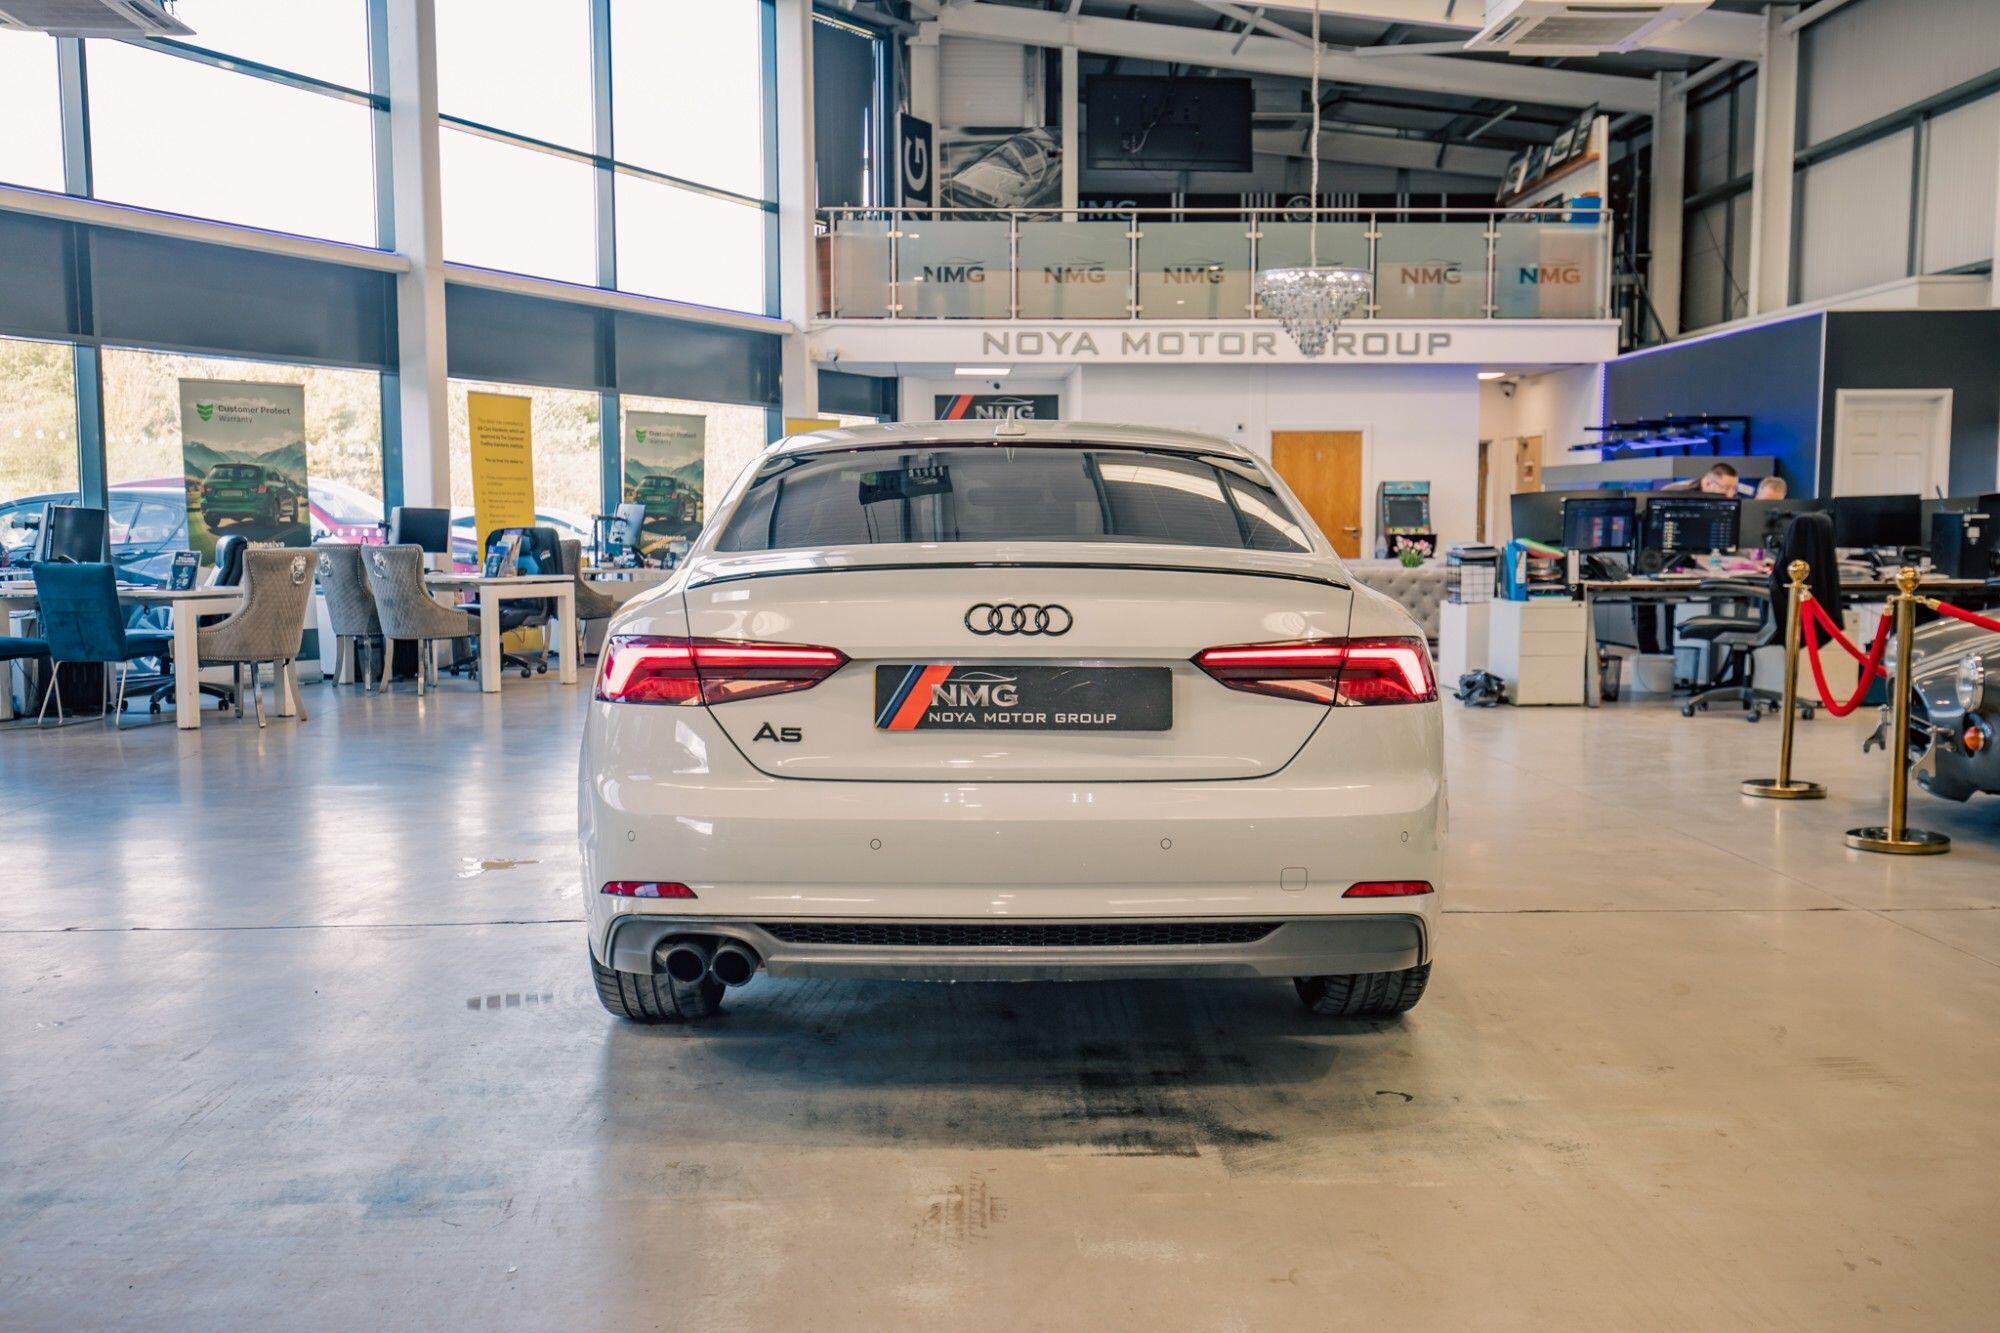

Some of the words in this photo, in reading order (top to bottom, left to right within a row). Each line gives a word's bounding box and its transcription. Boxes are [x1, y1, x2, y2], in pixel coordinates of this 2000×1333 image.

[922, 265, 985, 283] NMG
[1044, 266, 1106, 284] NMG
[1163, 266, 1225, 284] NMG
[1400, 267, 1463, 285] NMG
[1519, 267, 1581, 284] NMG
[982, 332, 1100, 356] NOYA
[1121, 332, 1277, 356] MOTOR
[1308, 332, 1452, 357] ROUP
[217, 404, 258, 414] Customer
[260, 406, 291, 415] Protect
[974, 405, 1036, 420] NMG
[930, 683, 1019, 707] NMG
[928, 712, 977, 723] NOYA
[983, 712, 1047, 723] MOTOR
[1054, 713, 1117, 724] GROUP
[752, 722, 803, 742] A5
